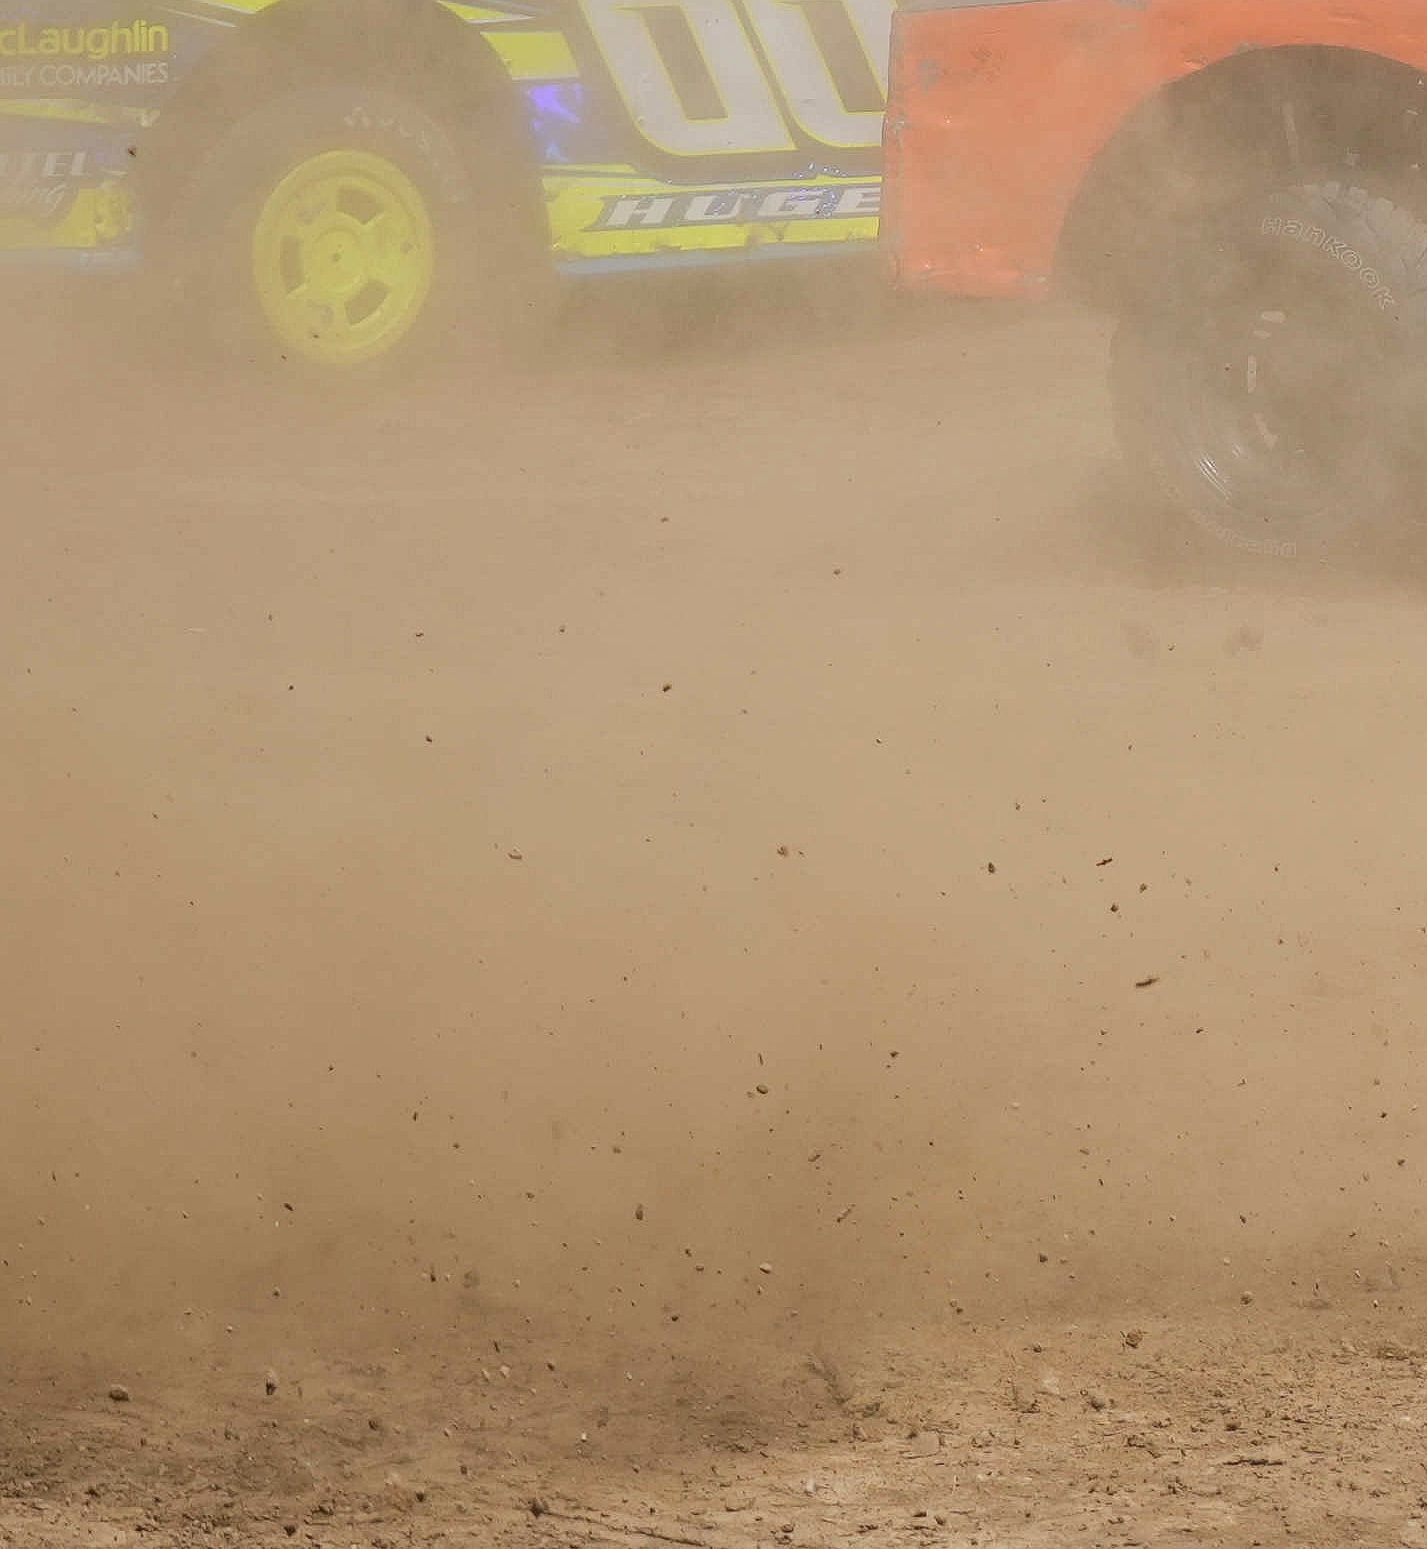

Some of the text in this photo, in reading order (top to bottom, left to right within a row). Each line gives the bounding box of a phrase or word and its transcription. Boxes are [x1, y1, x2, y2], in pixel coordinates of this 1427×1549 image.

[0, 19, 170, 60] cLaughlin
[40, 61, 170, 86] COMPANIES
[606, 185, 882, 227] HUGE
